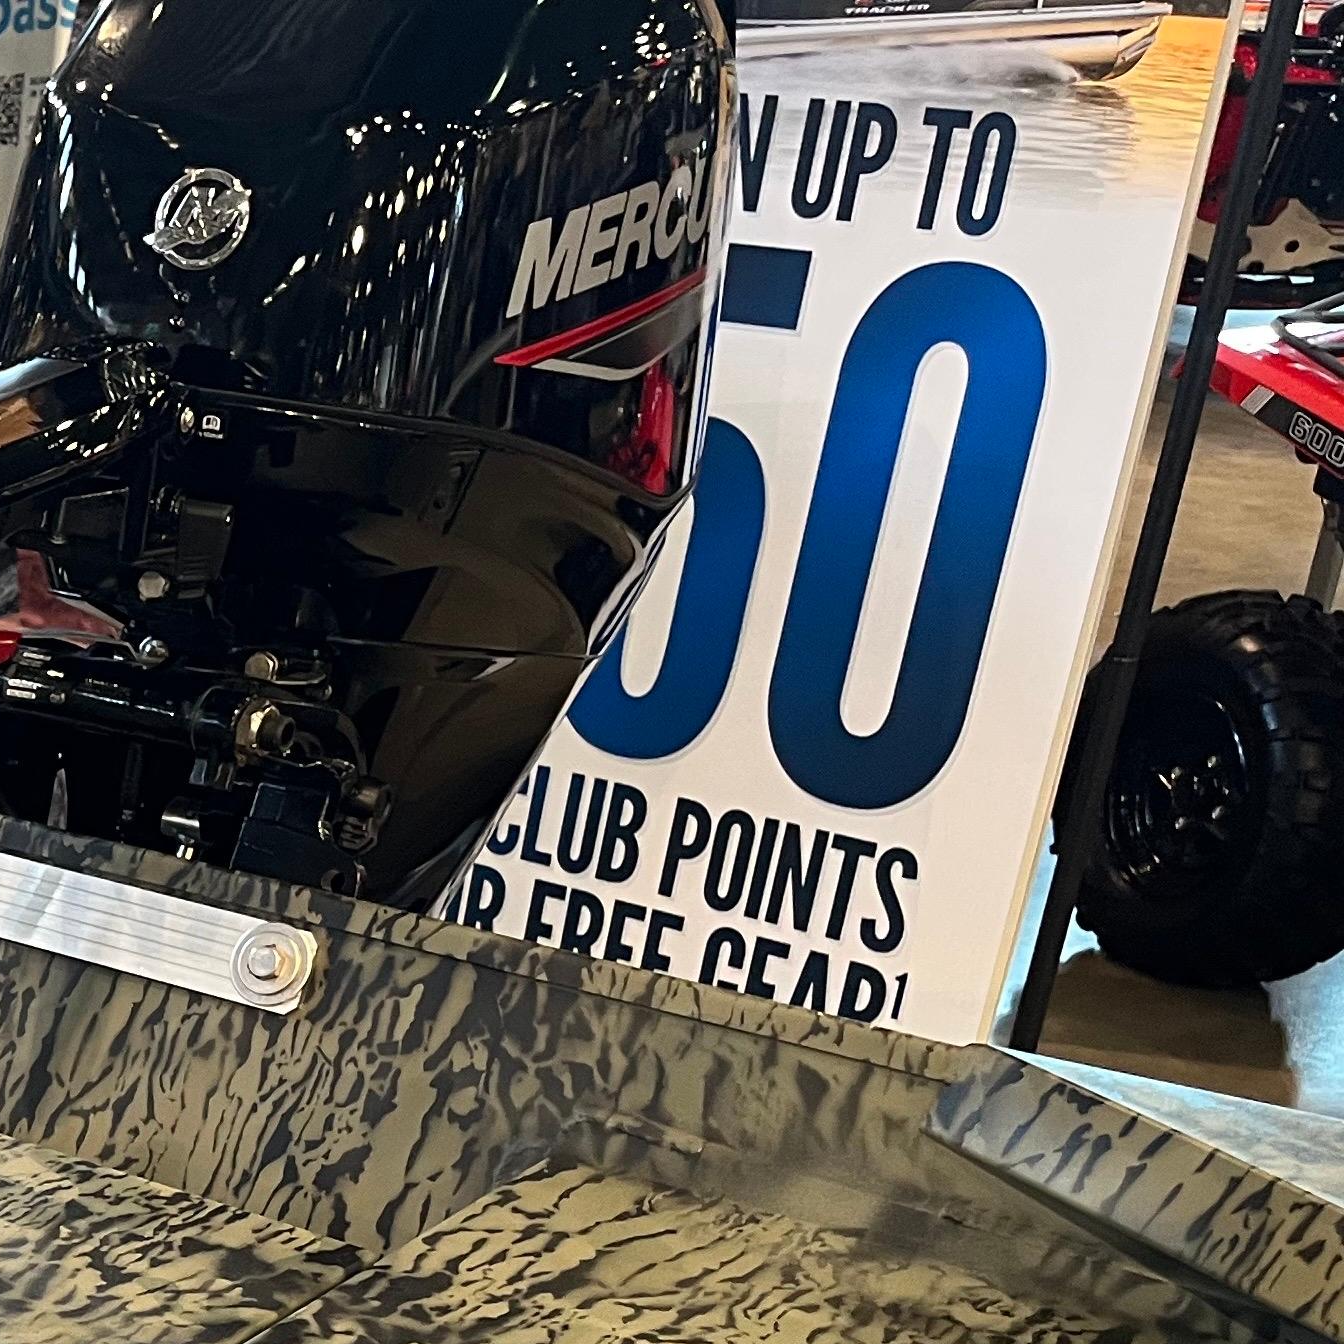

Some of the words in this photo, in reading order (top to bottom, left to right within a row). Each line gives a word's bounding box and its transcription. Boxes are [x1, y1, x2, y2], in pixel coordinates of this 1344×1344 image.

[791, 98, 898, 222] UP
[917, 107, 1017, 236] TO
[658, 797, 918, 952] POINTS
